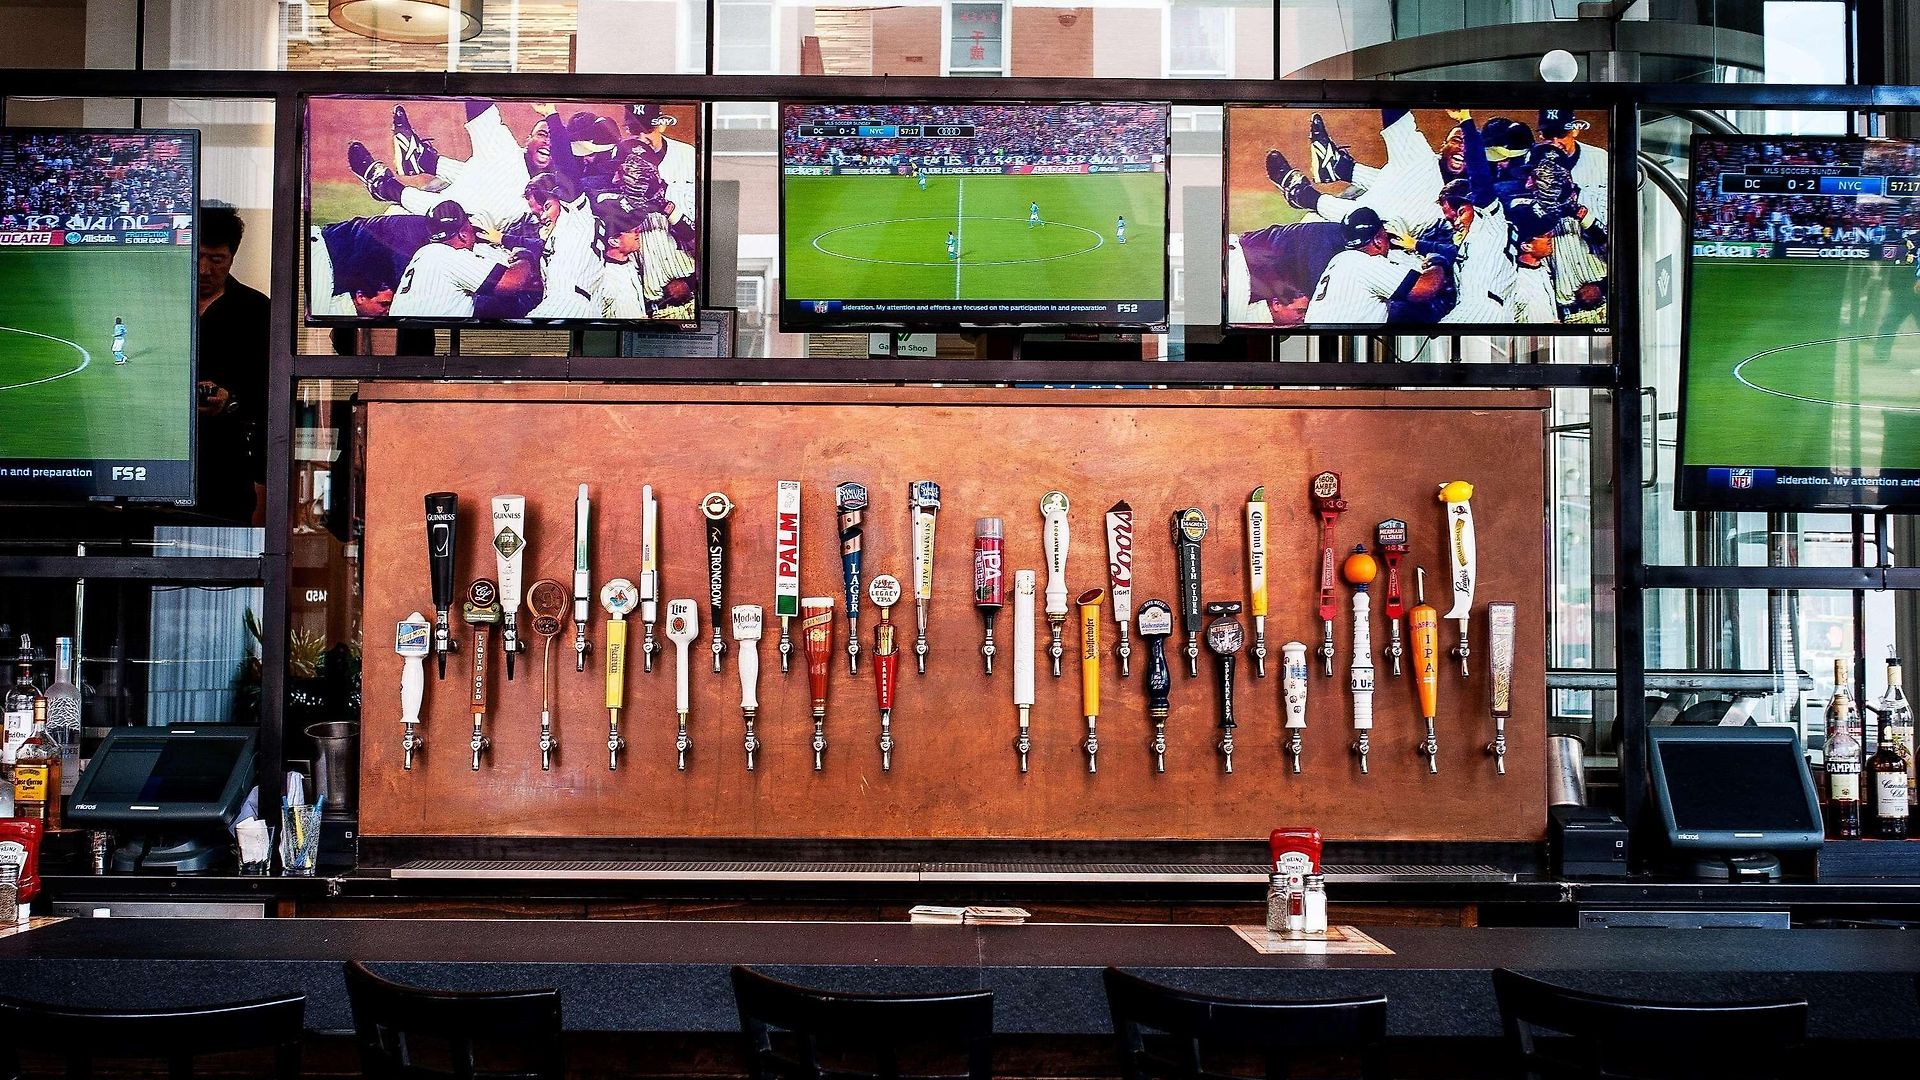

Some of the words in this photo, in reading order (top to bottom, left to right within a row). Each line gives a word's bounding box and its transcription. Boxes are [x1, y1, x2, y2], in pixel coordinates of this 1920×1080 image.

[651, 117, 673, 126] SNY
[1564, 121, 1587, 131] SNY
[1744, 180, 1761, 189] DC
[1838, 181, 1862, 191] NYC
[1890, 182, 1920, 191] 57:17
[81, 235, 118, 243] Allstate
[1818, 246, 1870, 258] adidas
[1117, 304, 1138, 312] FS2
[908, 344, 928, 352] Shop
[10, 467, 30, 476] and
[32, 468, 92, 478] preparation
[112, 466, 146, 480] FS2
[1732, 478, 1752, 488] NFL
[1776, 475, 1831, 485] sideration.
[1833, 477, 1848, 488] My
[1851, 477, 1898, 486] attention
[1901, 478, 1920, 487] and
[840, 488, 864, 496] SAMUEL
[1250, 511, 1262, 548] Corona
[779, 512, 797, 577] PALM
[1110, 512, 1132, 589] Coors
[983, 550, 1001, 580] IPA
[1252, 551, 1263, 575] Light
[710, 546, 722, 606] STRONGBOW
[850, 563, 860, 612] LAGER
[670, 603, 687, 615] Lite
[734, 613, 760, 623] Modelo
[1424, 634, 1435, 672] IPA
